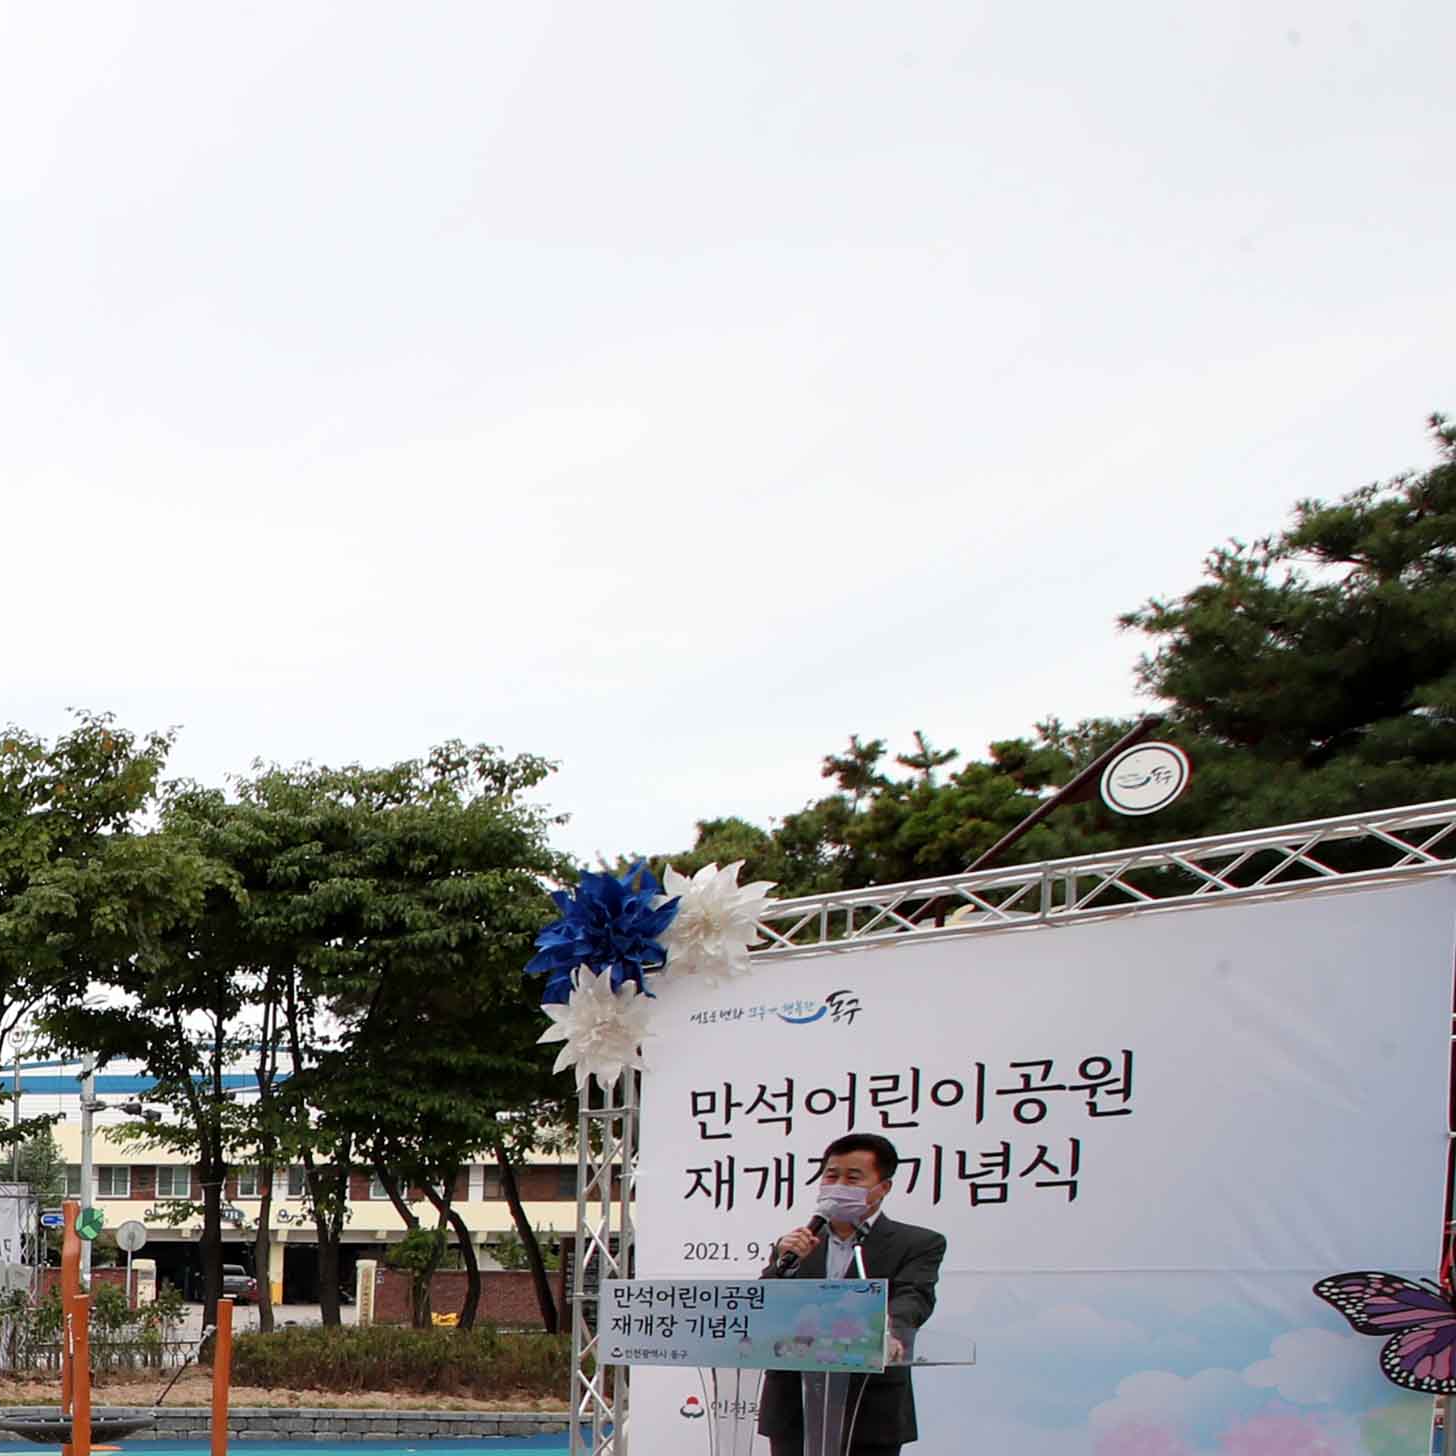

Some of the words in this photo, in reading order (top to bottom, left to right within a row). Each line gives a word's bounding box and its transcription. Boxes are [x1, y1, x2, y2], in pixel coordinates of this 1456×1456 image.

[825, 989, 862, 1025] 동구
[690, 1048, 1134, 1140] 만석어린이공원
[898, 1137, 1081, 1207] 기념식
[683, 1242, 739, 1262] 2021.
[613, 1285, 766, 1311] 만석어린이공원
[611, 1315, 678, 1338] 재개장
[687, 1316, 749, 1340] 기념식
[624, 1347, 668, 1360] 인천광역시
[670, 1348, 688, 1360] 동구
